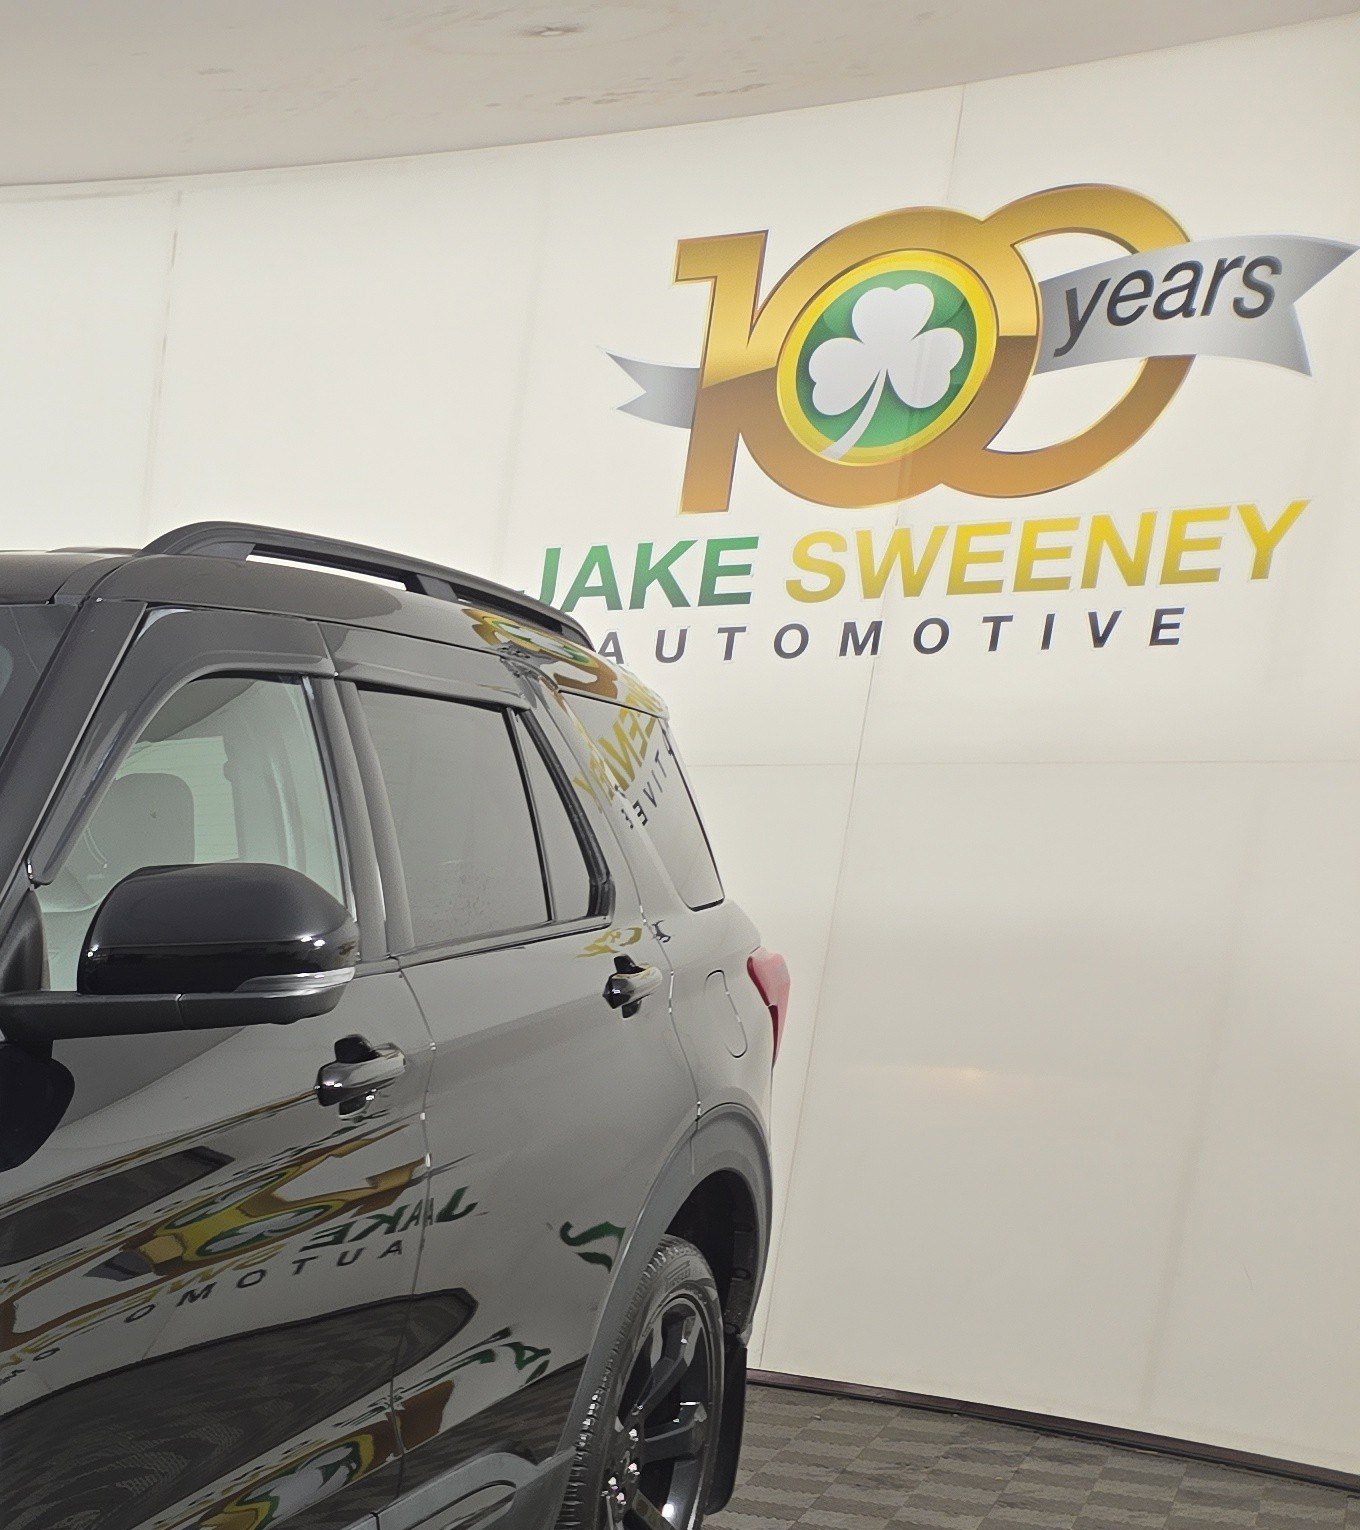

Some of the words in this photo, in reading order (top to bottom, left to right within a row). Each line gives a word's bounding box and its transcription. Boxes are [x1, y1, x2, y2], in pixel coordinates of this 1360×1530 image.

[674, 183, 1193, 514] 100
[1054, 253, 1283, 358] years
[536, 535, 760, 613] JAKE
[784, 499, 1311, 603] SWEENEY
[597, 607, 1186, 664] AUTOMOTIVE
